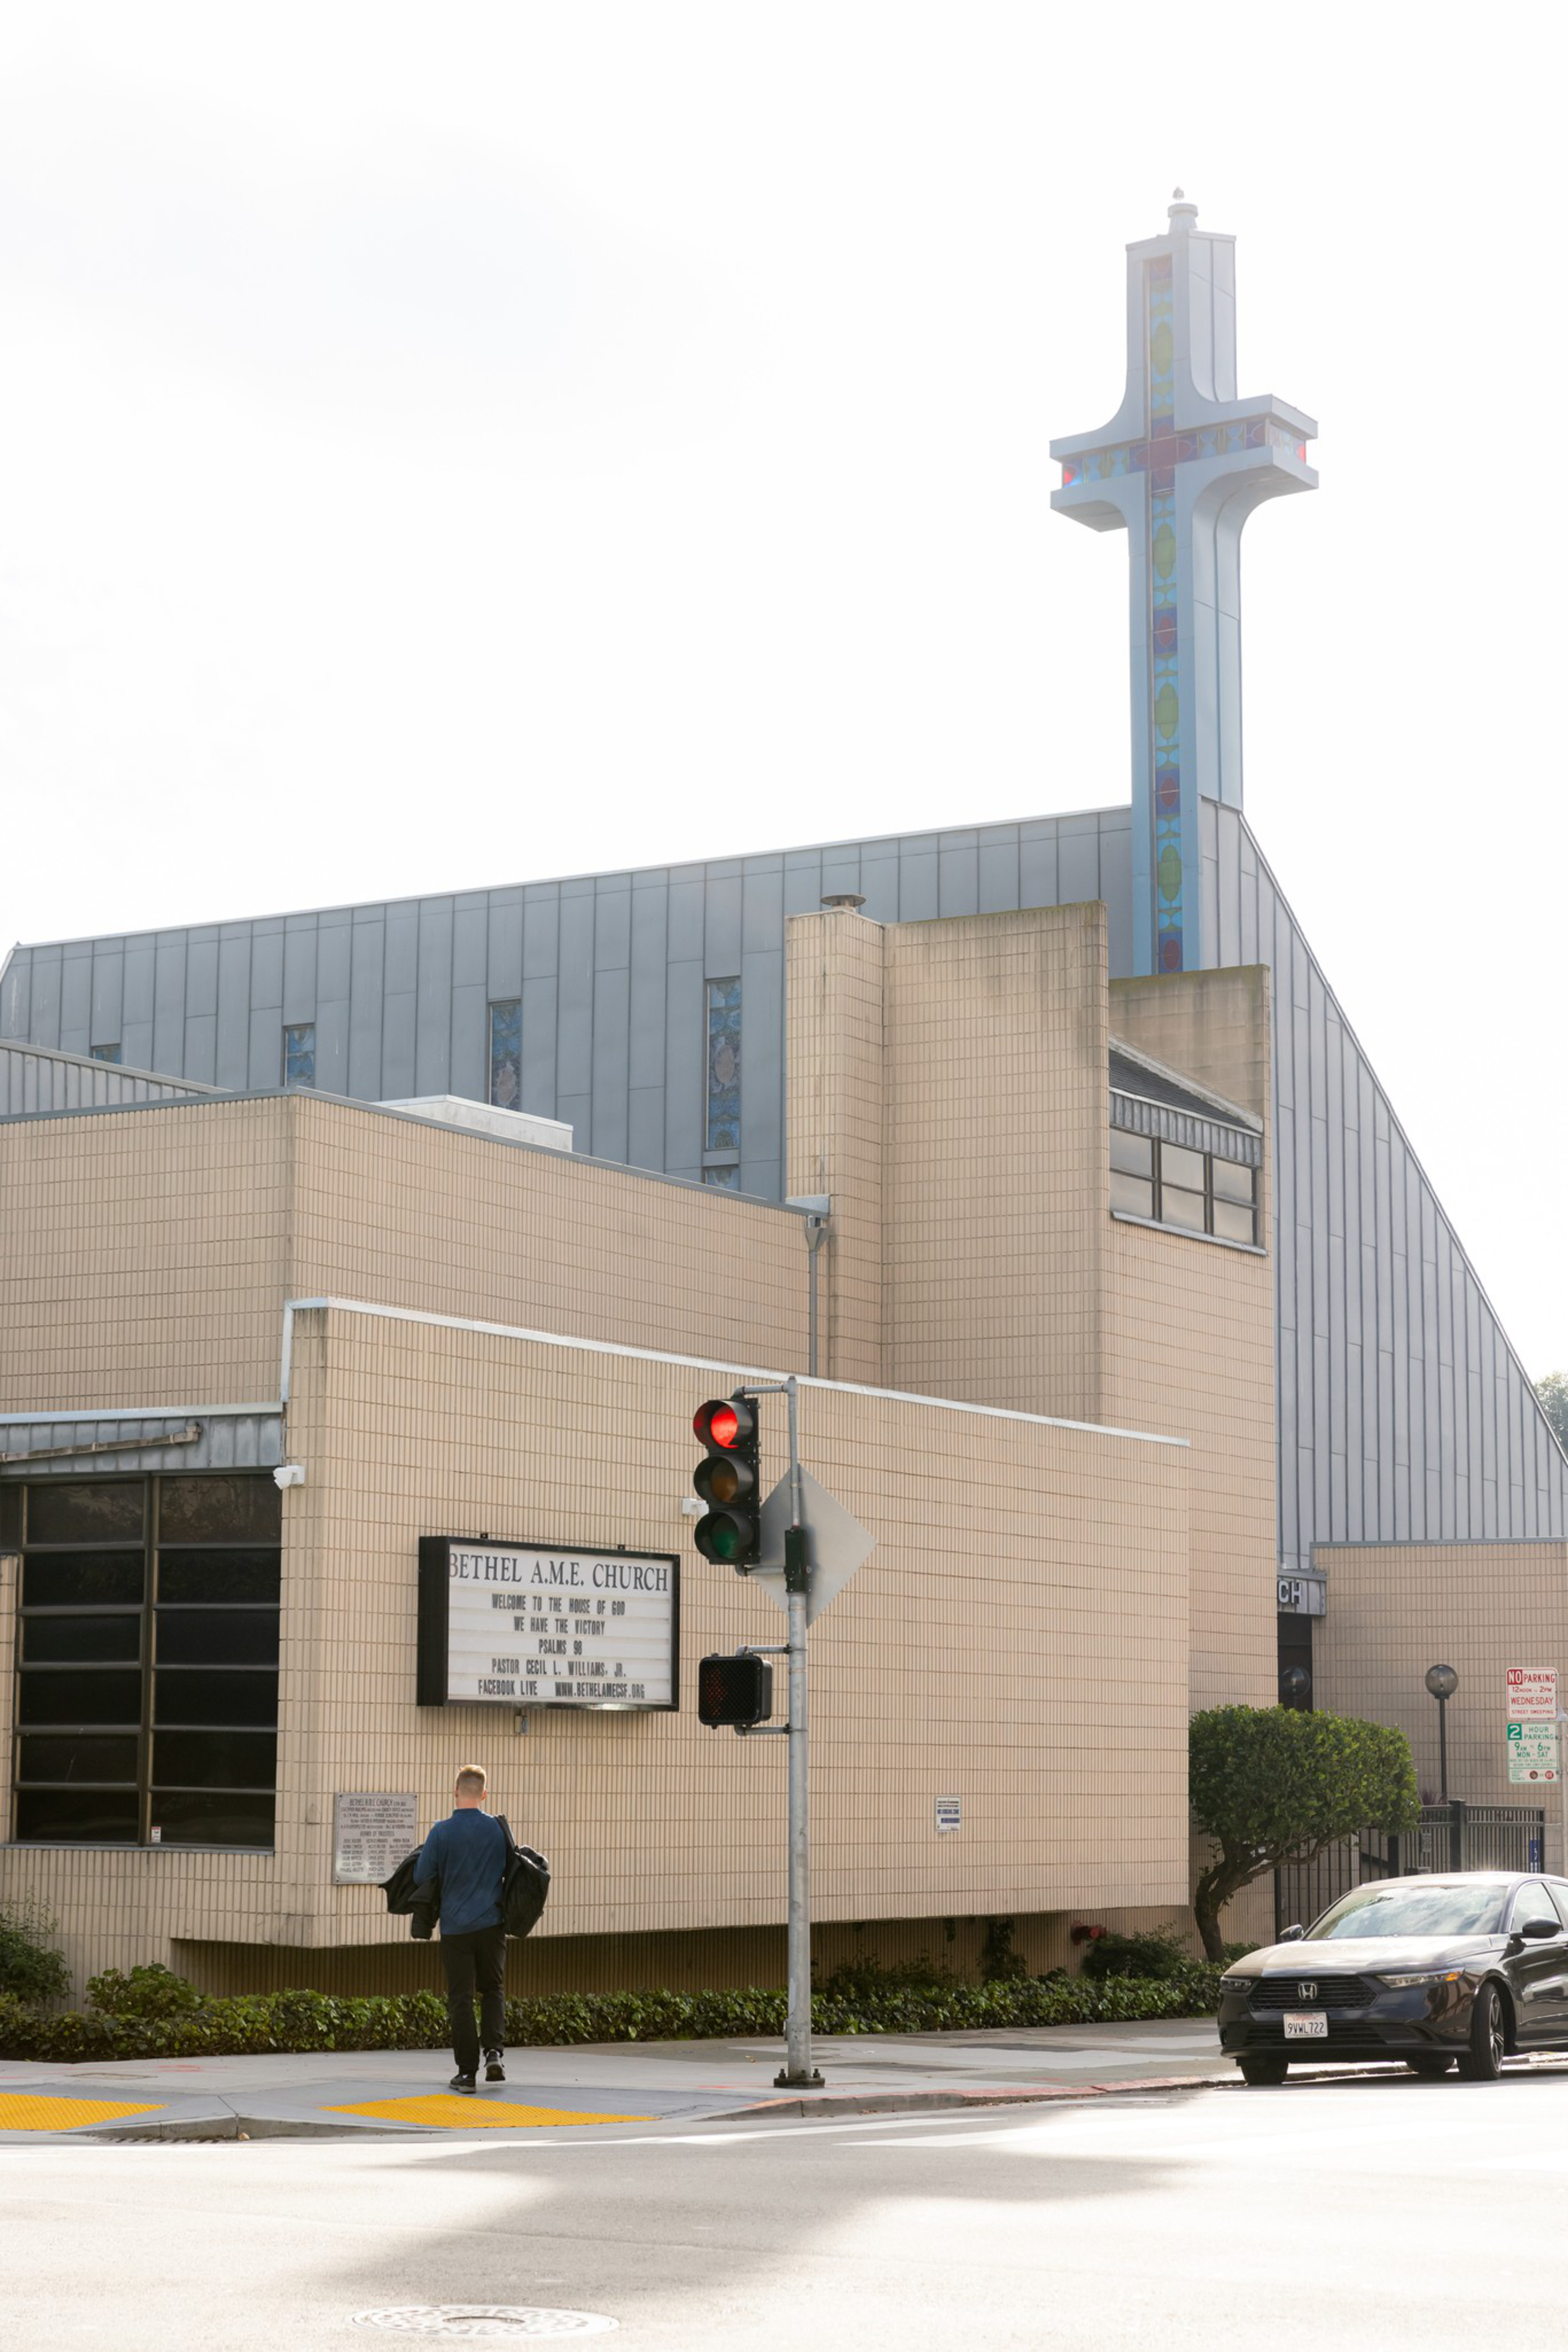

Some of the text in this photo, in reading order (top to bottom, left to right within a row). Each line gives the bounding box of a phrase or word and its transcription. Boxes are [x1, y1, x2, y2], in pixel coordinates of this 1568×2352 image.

[449, 1553, 668, 1591] BETHEL A.M.E. CHURCH
[1278, 1580, 1301, 1604] CH
[492, 1593, 625, 1615] WELCOME TO THE HOUSE OF GOD
[514, 1616, 605, 1635] WE HAVE THE VICTORY
[539, 1639, 582, 1655] PSALMS 98
[492, 1658, 520, 1674] PASTOR
[526, 1659, 547, 1675] CECIL
[553, 1660, 561, 1675] L.
[614, 1663, 626, 1677] JR.
[1508, 1670, 1555, 1683] NO PARKING
[478, 1680, 645, 1698] FACEBOOK LIVE WWW.BETHELAMECSF.ORG
[1511, 1697, 1553, 1705] WEDNESDAY
[1510, 1725, 1520, 1739] 2
[1514, 1742, 1527, 1751] 9AM
[1538, 1742, 1550, 1751] 6PM
